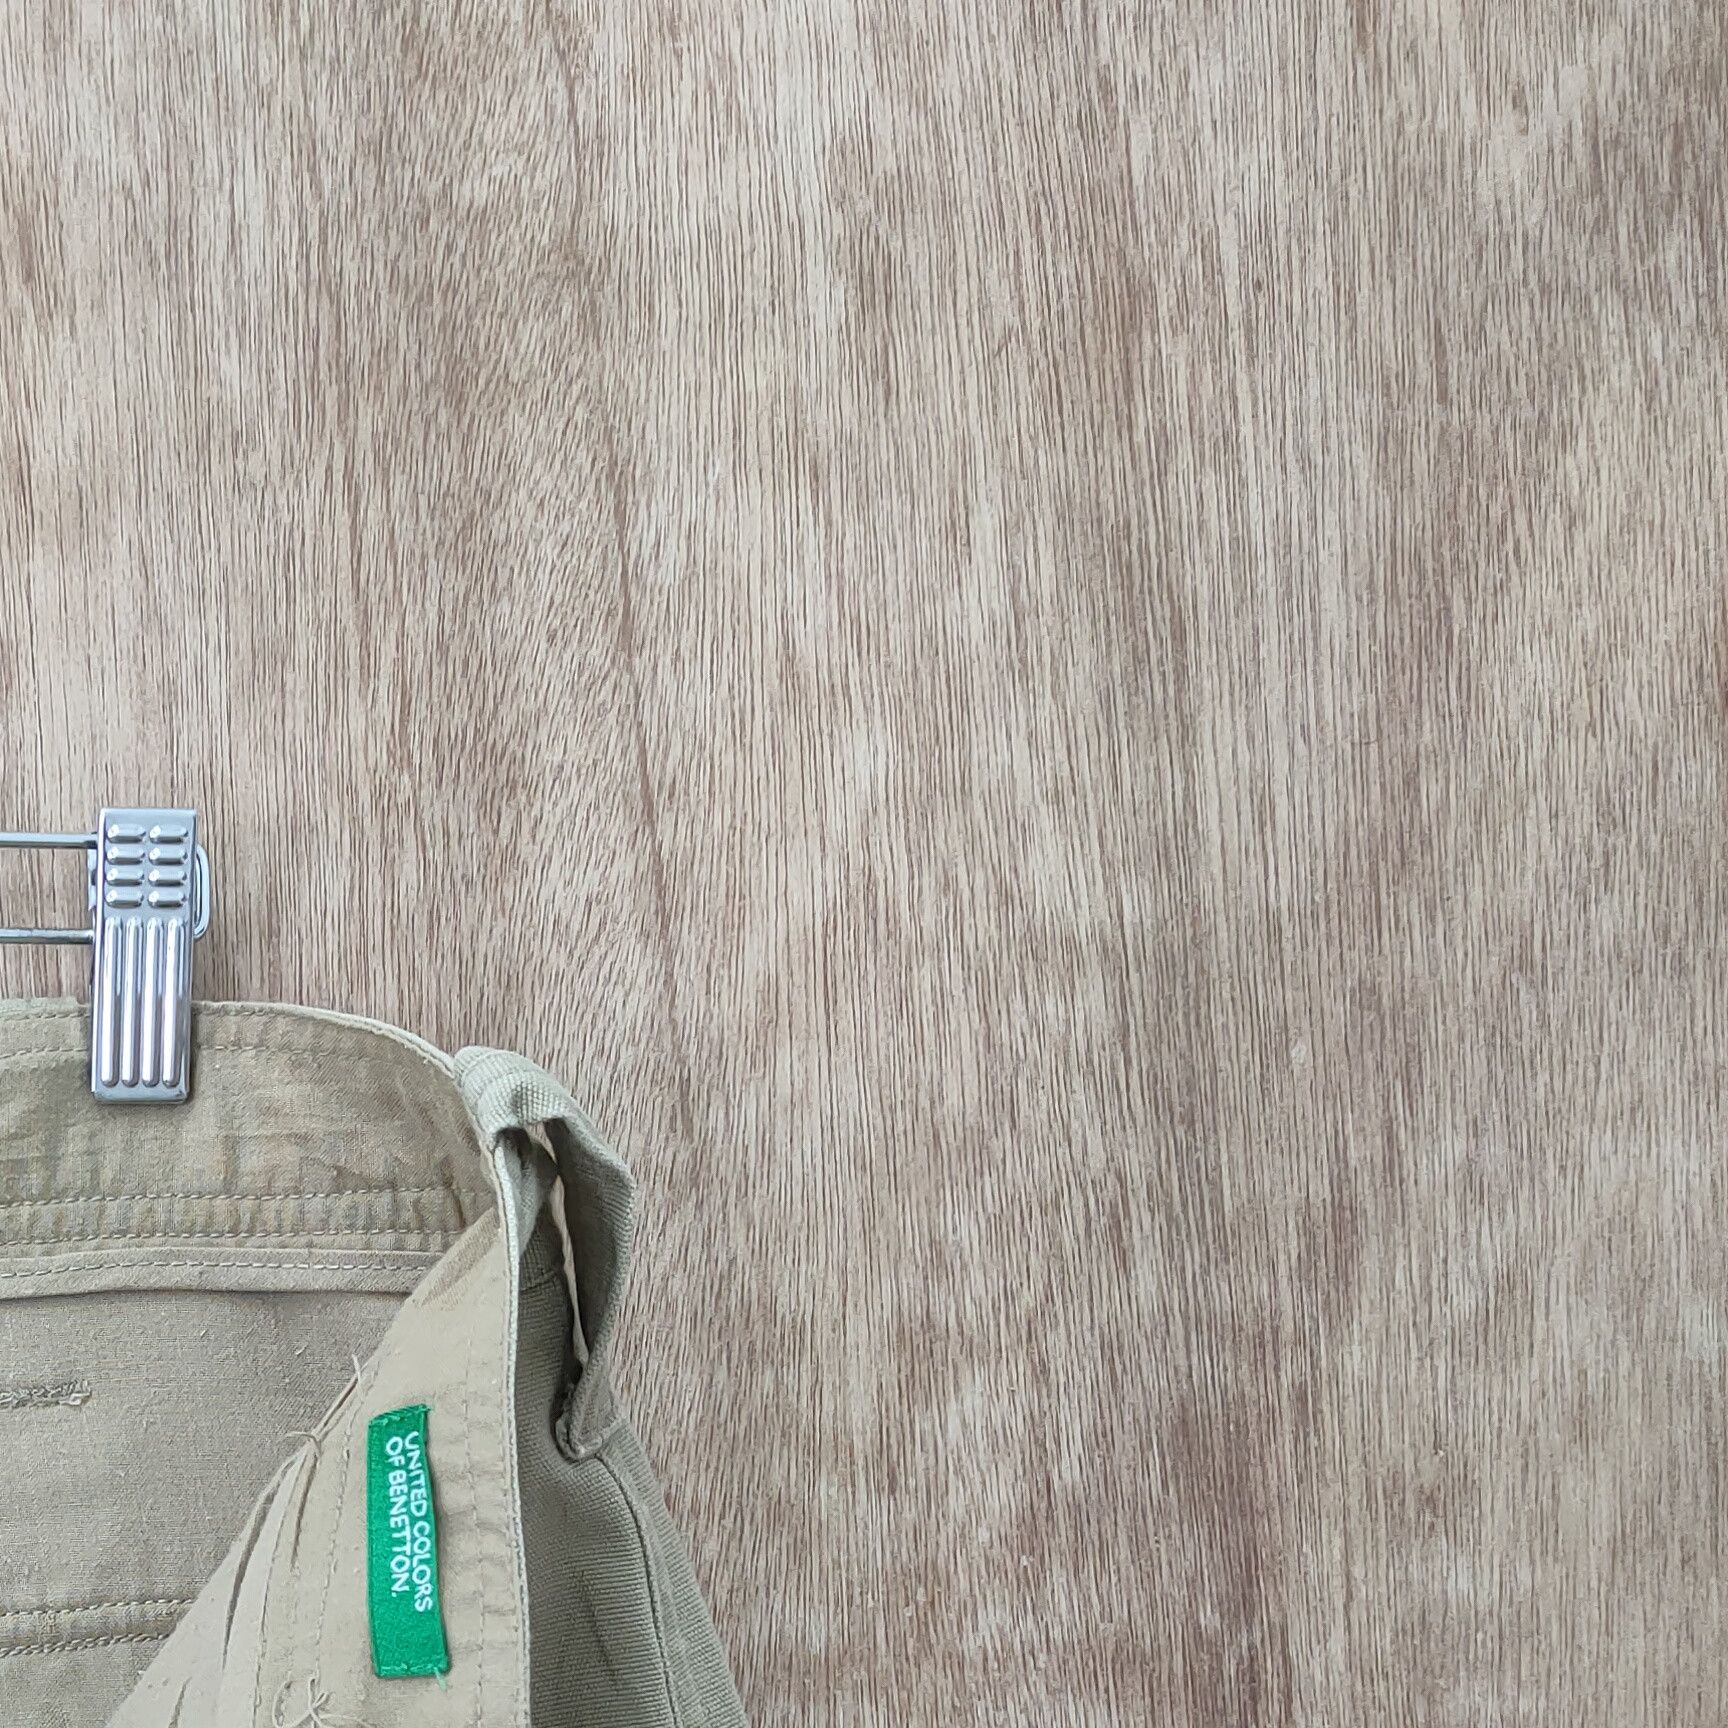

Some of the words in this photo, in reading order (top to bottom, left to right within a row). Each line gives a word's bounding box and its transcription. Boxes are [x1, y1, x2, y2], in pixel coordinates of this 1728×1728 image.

[385, 1435, 406, 1468] OF
[404, 1431, 428, 1518] UNITED
[387, 1469, 412, 1598] BENETTON.
[412, 1520, 433, 1613] COLORS
